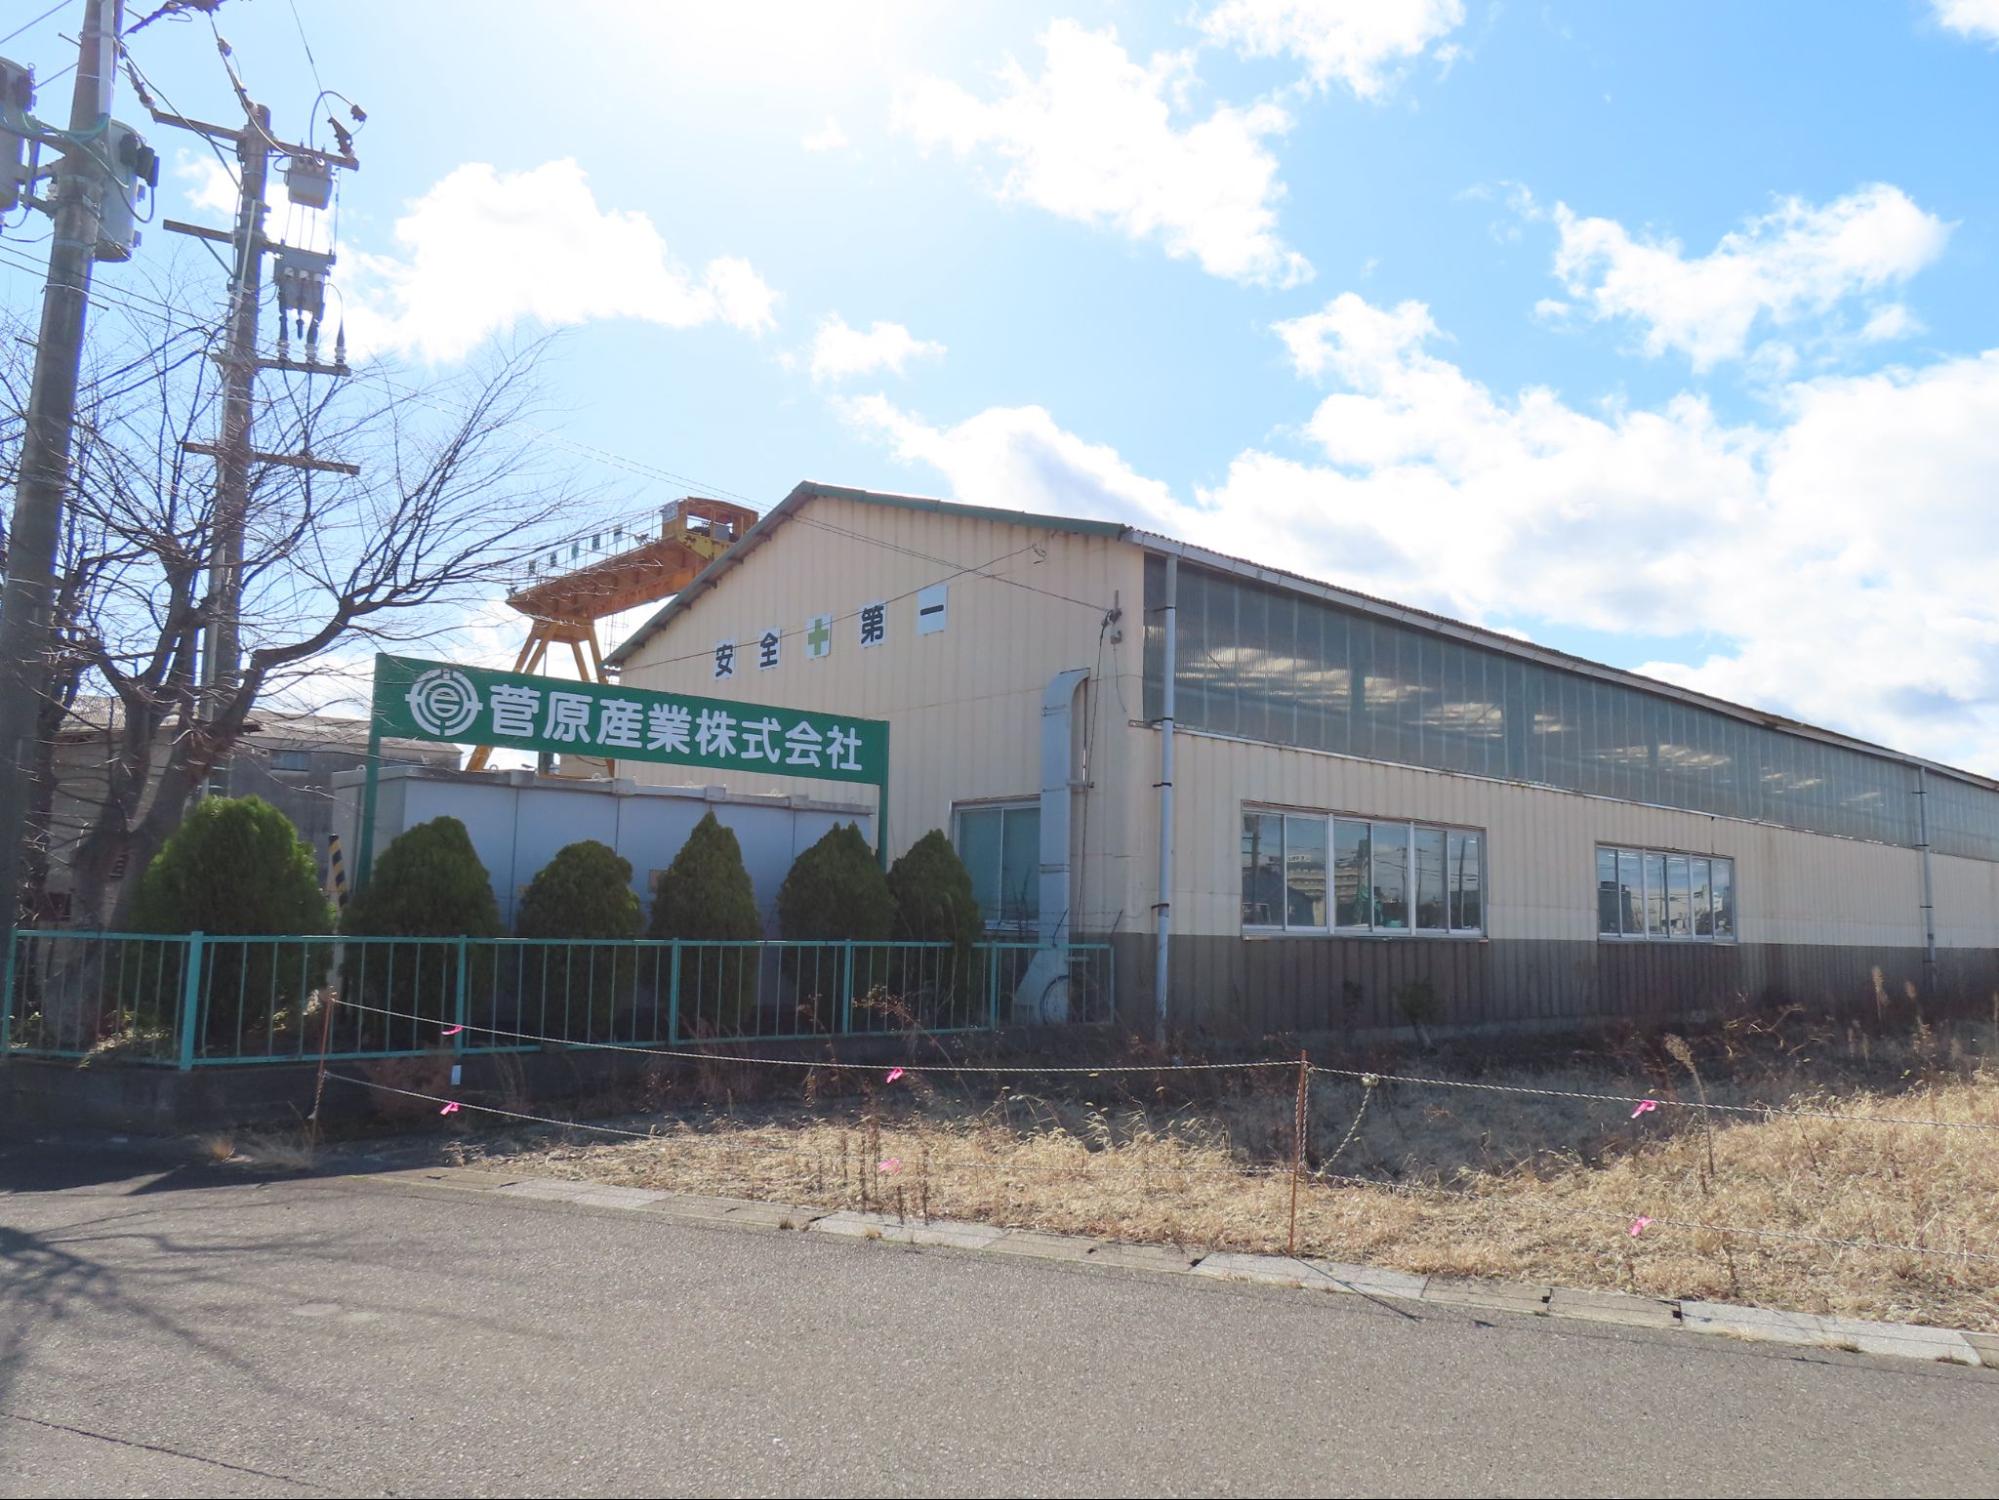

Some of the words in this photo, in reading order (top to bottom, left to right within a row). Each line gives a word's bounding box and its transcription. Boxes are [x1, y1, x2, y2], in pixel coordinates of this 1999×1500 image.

[489, 682, 864, 772] 菅原産業株式会社
